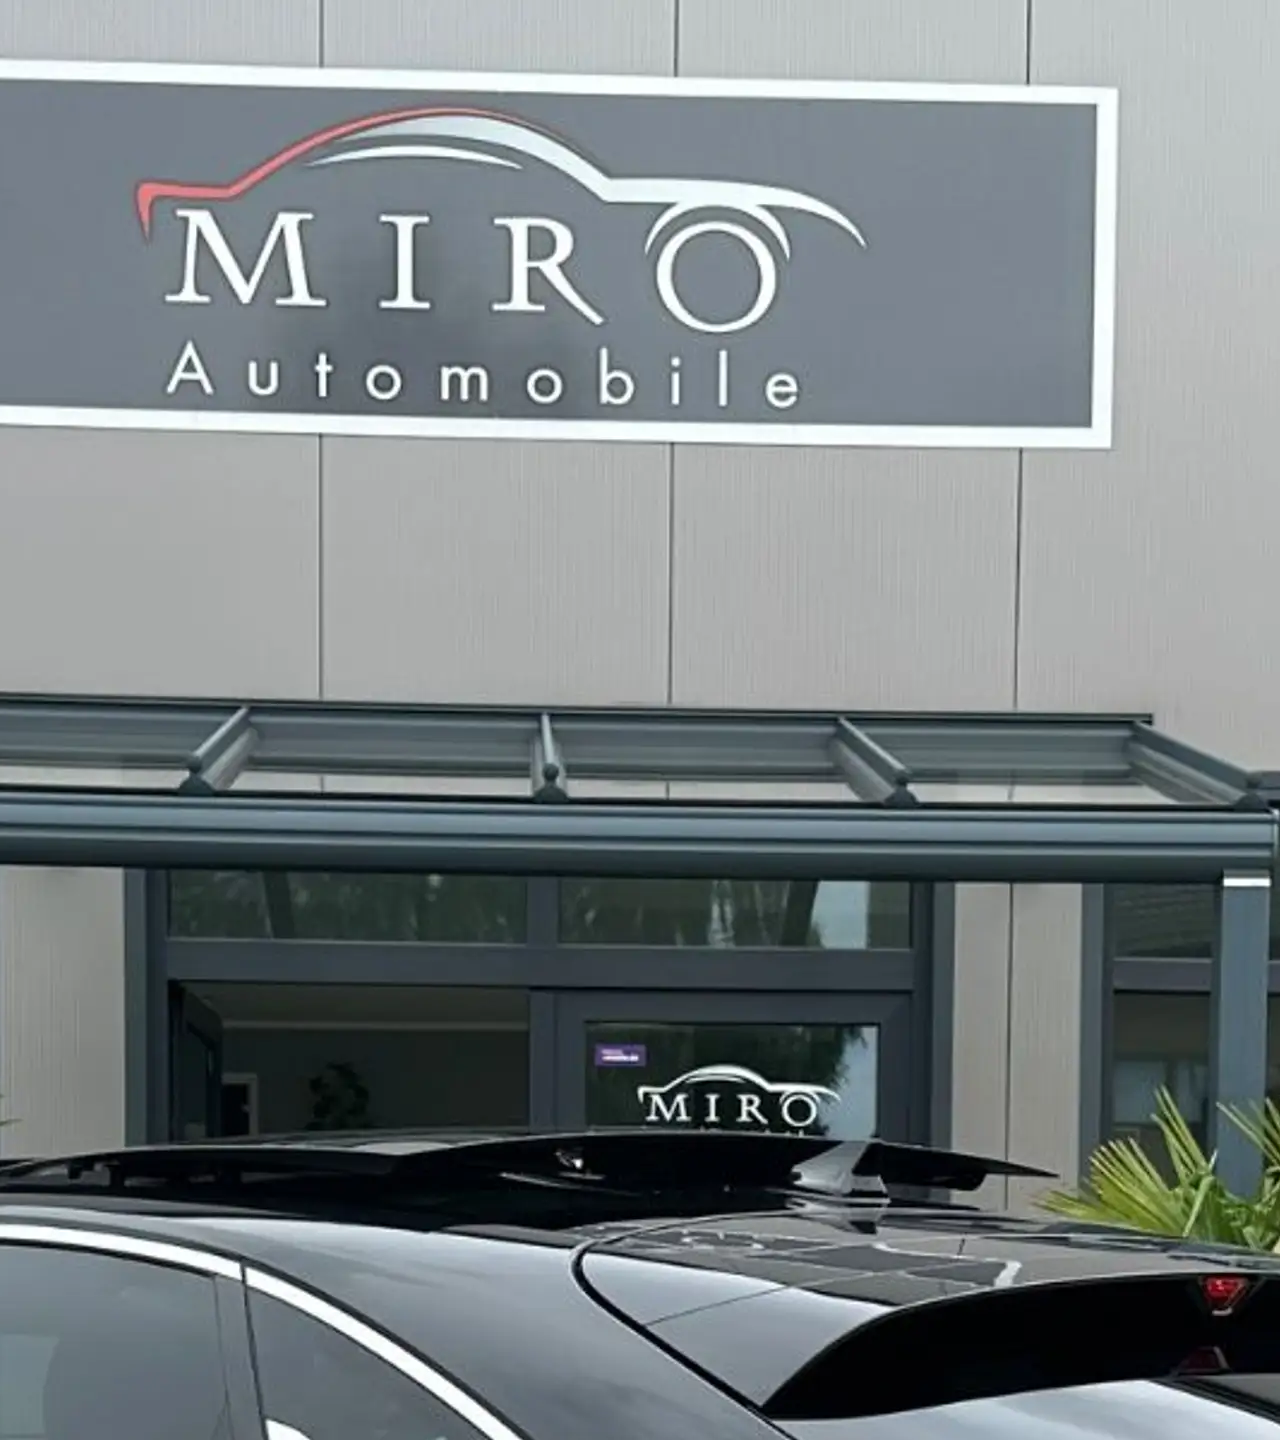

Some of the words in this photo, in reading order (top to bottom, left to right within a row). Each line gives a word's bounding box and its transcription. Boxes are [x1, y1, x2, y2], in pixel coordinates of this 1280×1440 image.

[165, 207, 777, 333] MIRO
[165, 340, 800, 409] Automobile
[645, 1093, 818, 1128] MIRO
